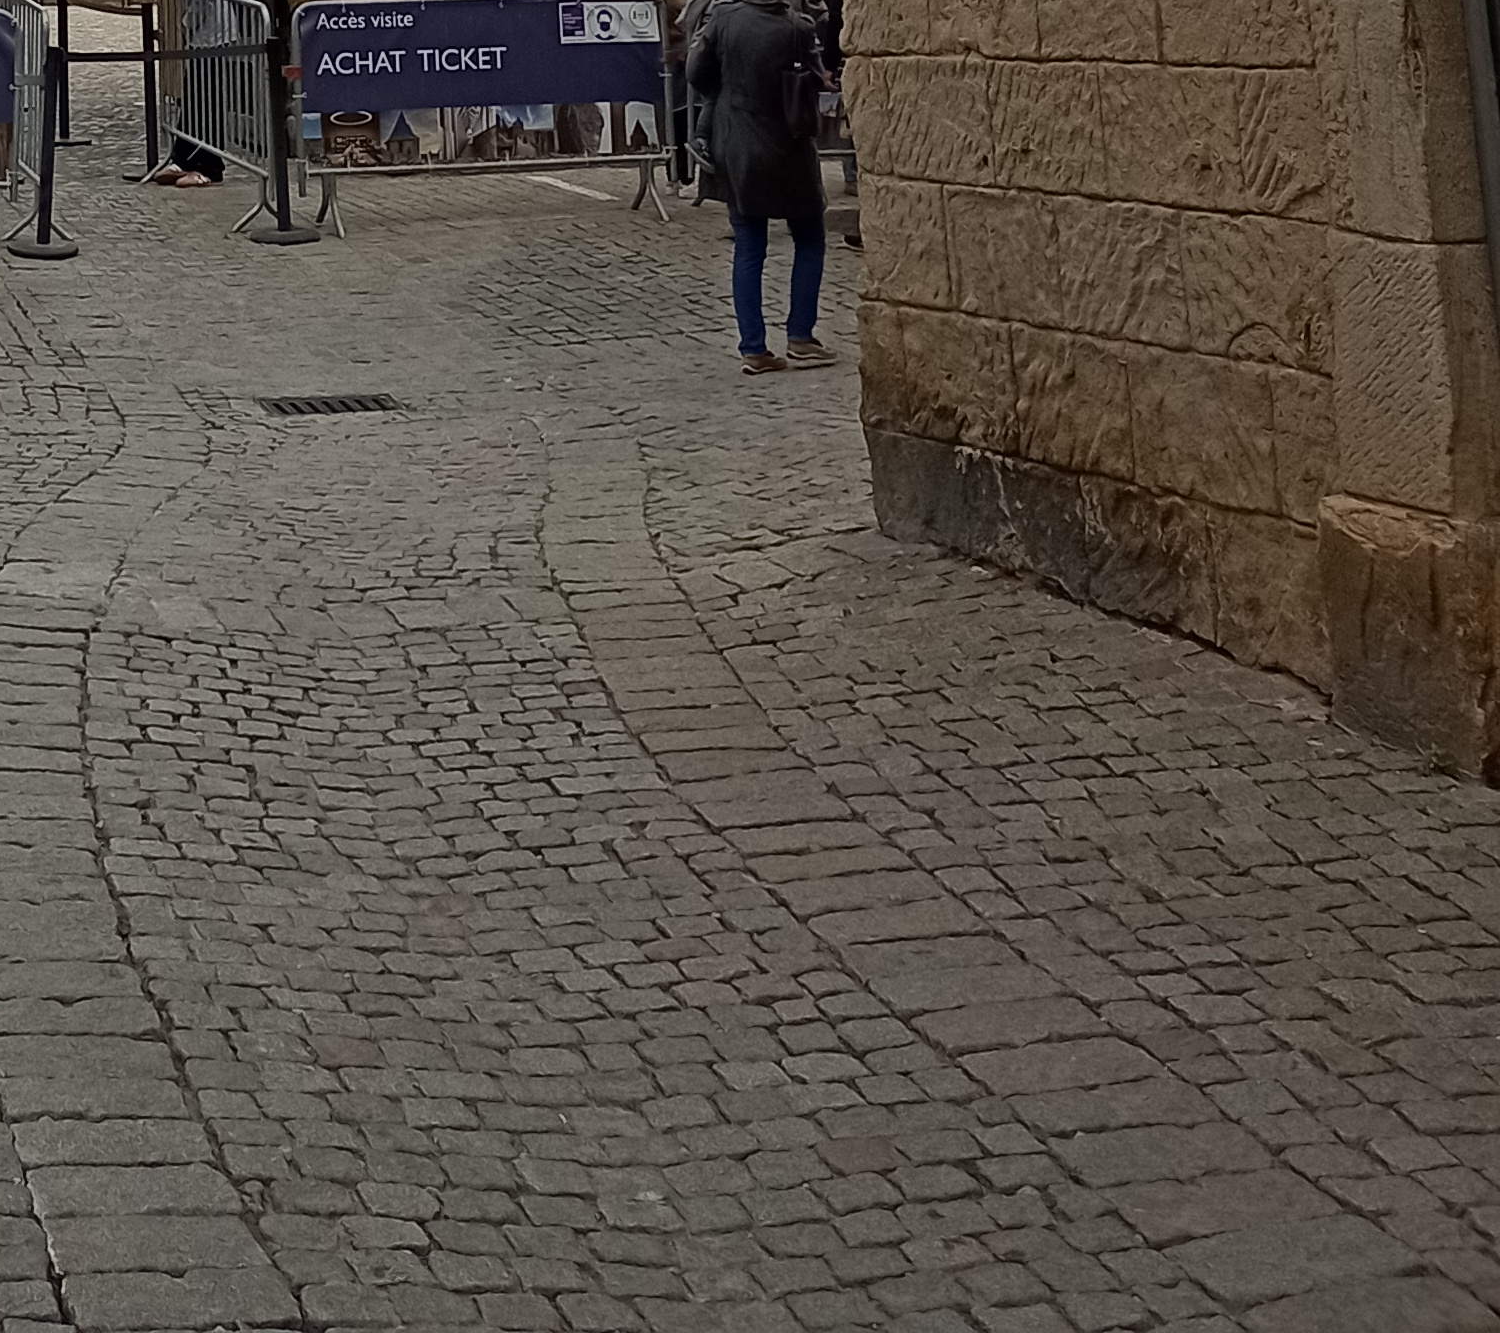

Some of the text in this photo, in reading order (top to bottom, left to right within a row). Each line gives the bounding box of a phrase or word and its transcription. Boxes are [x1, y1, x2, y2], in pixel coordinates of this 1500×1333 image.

[316, 11, 414, 30] Accès visite
[316, 46, 507, 76] ACHAT TICKET
